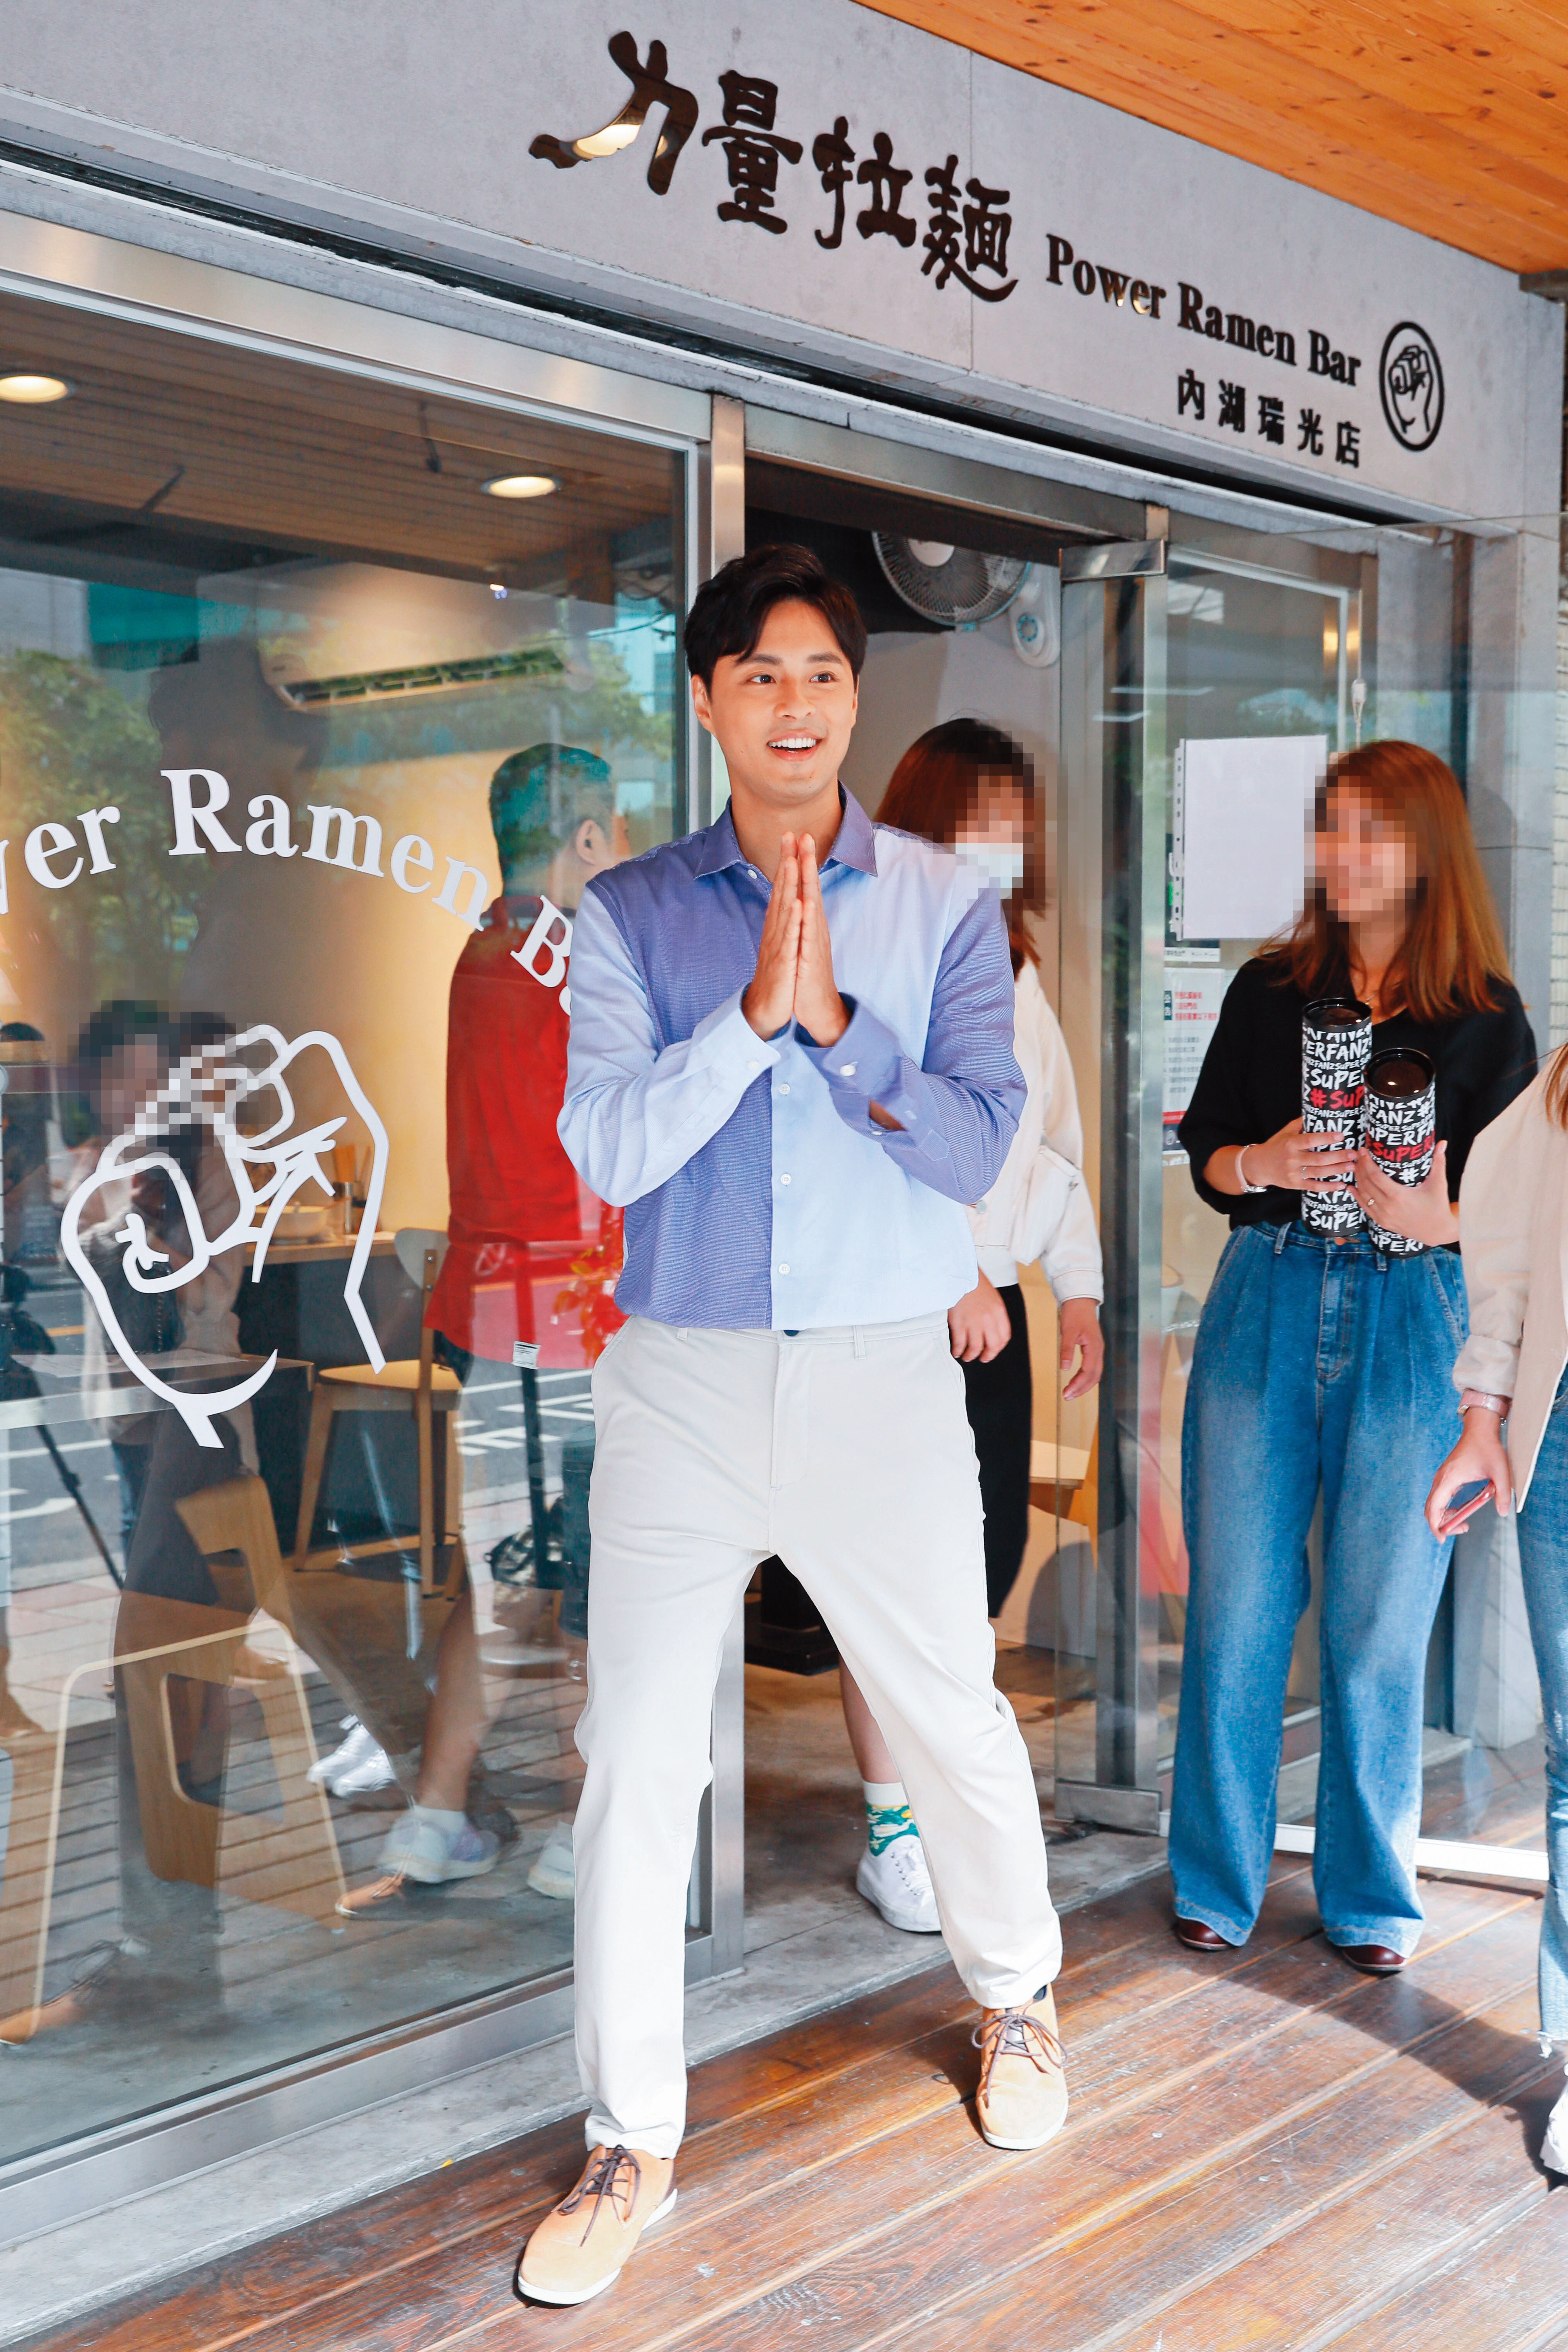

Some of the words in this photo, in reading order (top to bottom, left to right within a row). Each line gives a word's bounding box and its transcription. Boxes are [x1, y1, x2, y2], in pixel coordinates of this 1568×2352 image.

[528, 31, 1019, 302] 力量拉麵
[1045, 234, 1166, 320] Power
[1177, 281, 1297, 366] Ramen
[1308, 329, 1361, 387] Bar
[0, 805, 121, 915] er
[160, 768, 490, 932] Ramen
[510, 894, 573, 1016] B
